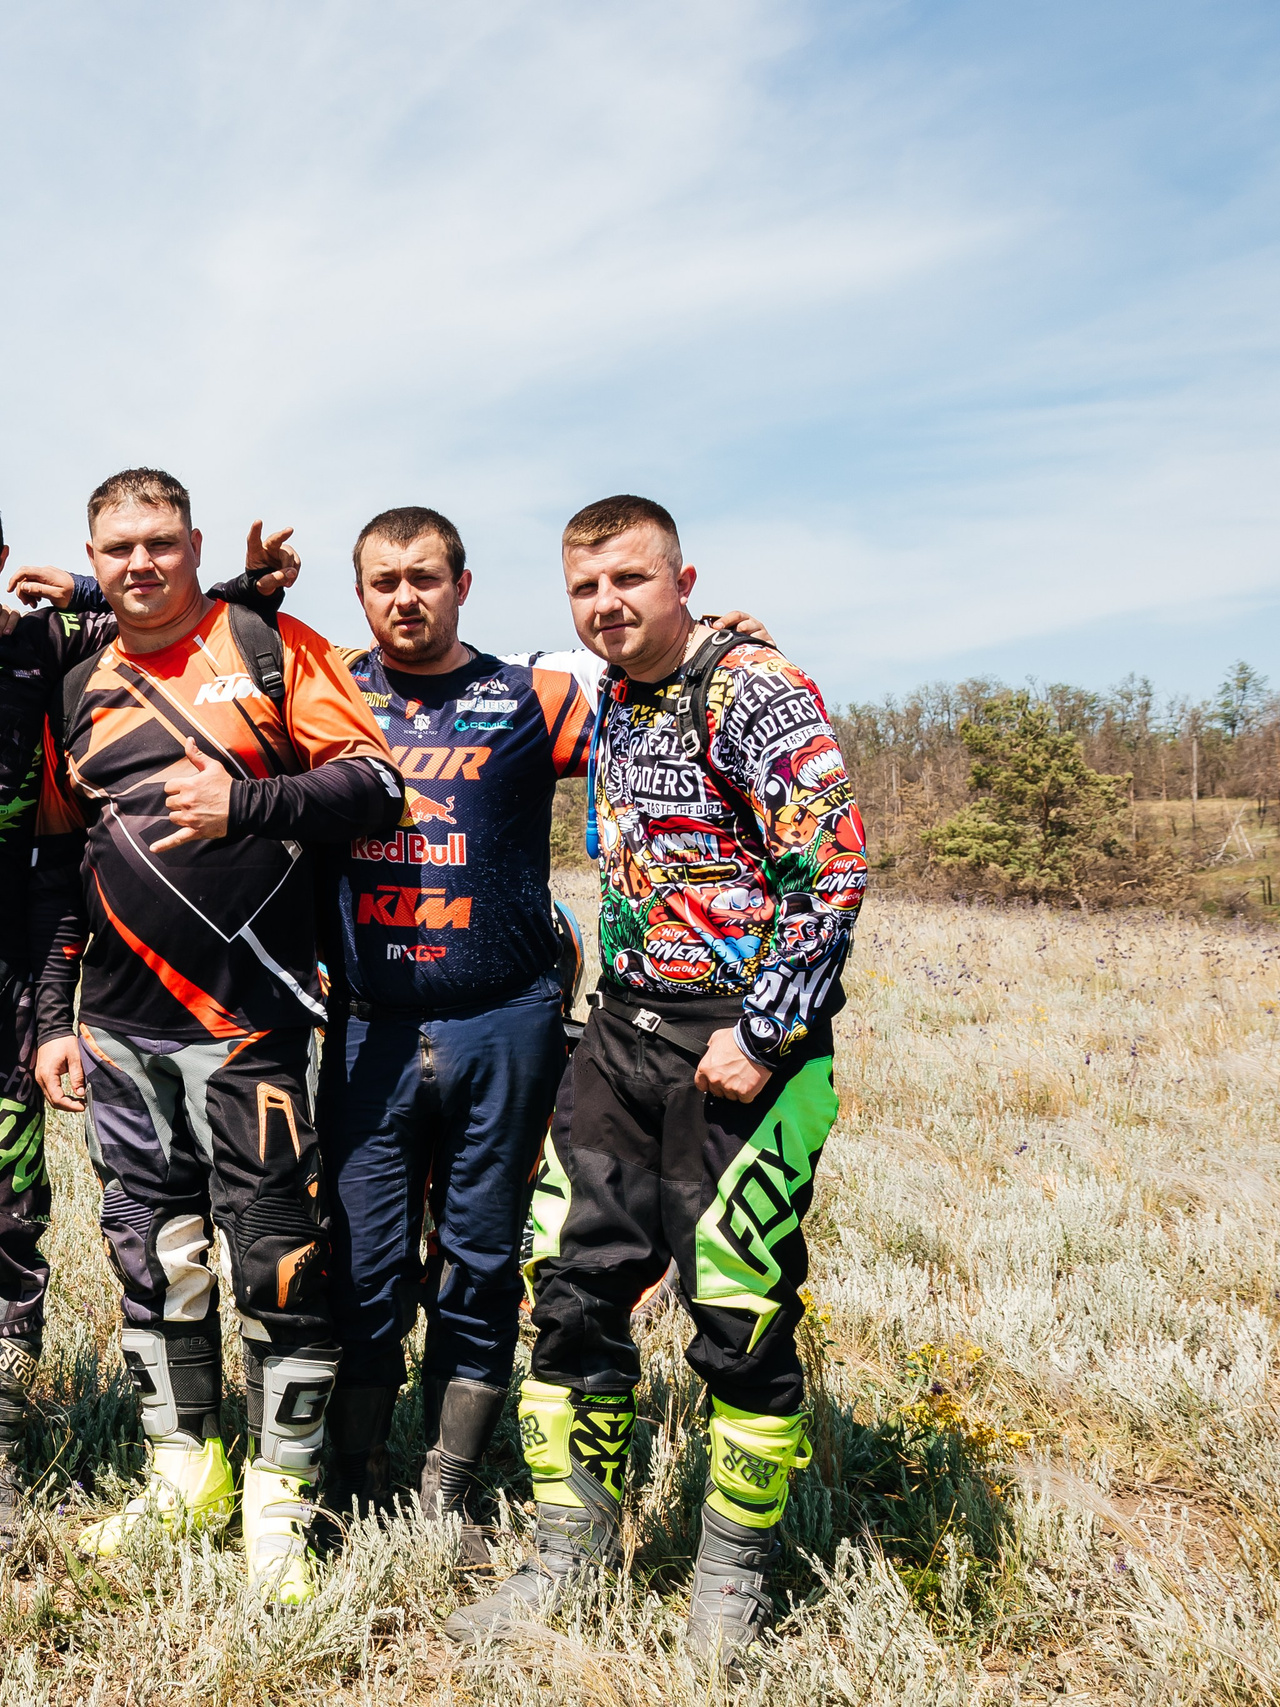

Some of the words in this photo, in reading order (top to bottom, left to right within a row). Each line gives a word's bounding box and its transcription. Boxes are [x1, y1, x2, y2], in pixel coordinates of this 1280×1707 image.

[193, 672, 262, 706] KTM
[351, 831, 405, 863] Red
[408, 833, 467, 867] Bull
[357, 885, 473, 929] KTM
[662, 928, 690, 941] High
[755, 1020, 771, 1034] 19
[716, 1120, 802, 1277] FOX
[581, 1394, 629, 1404] TIGER
